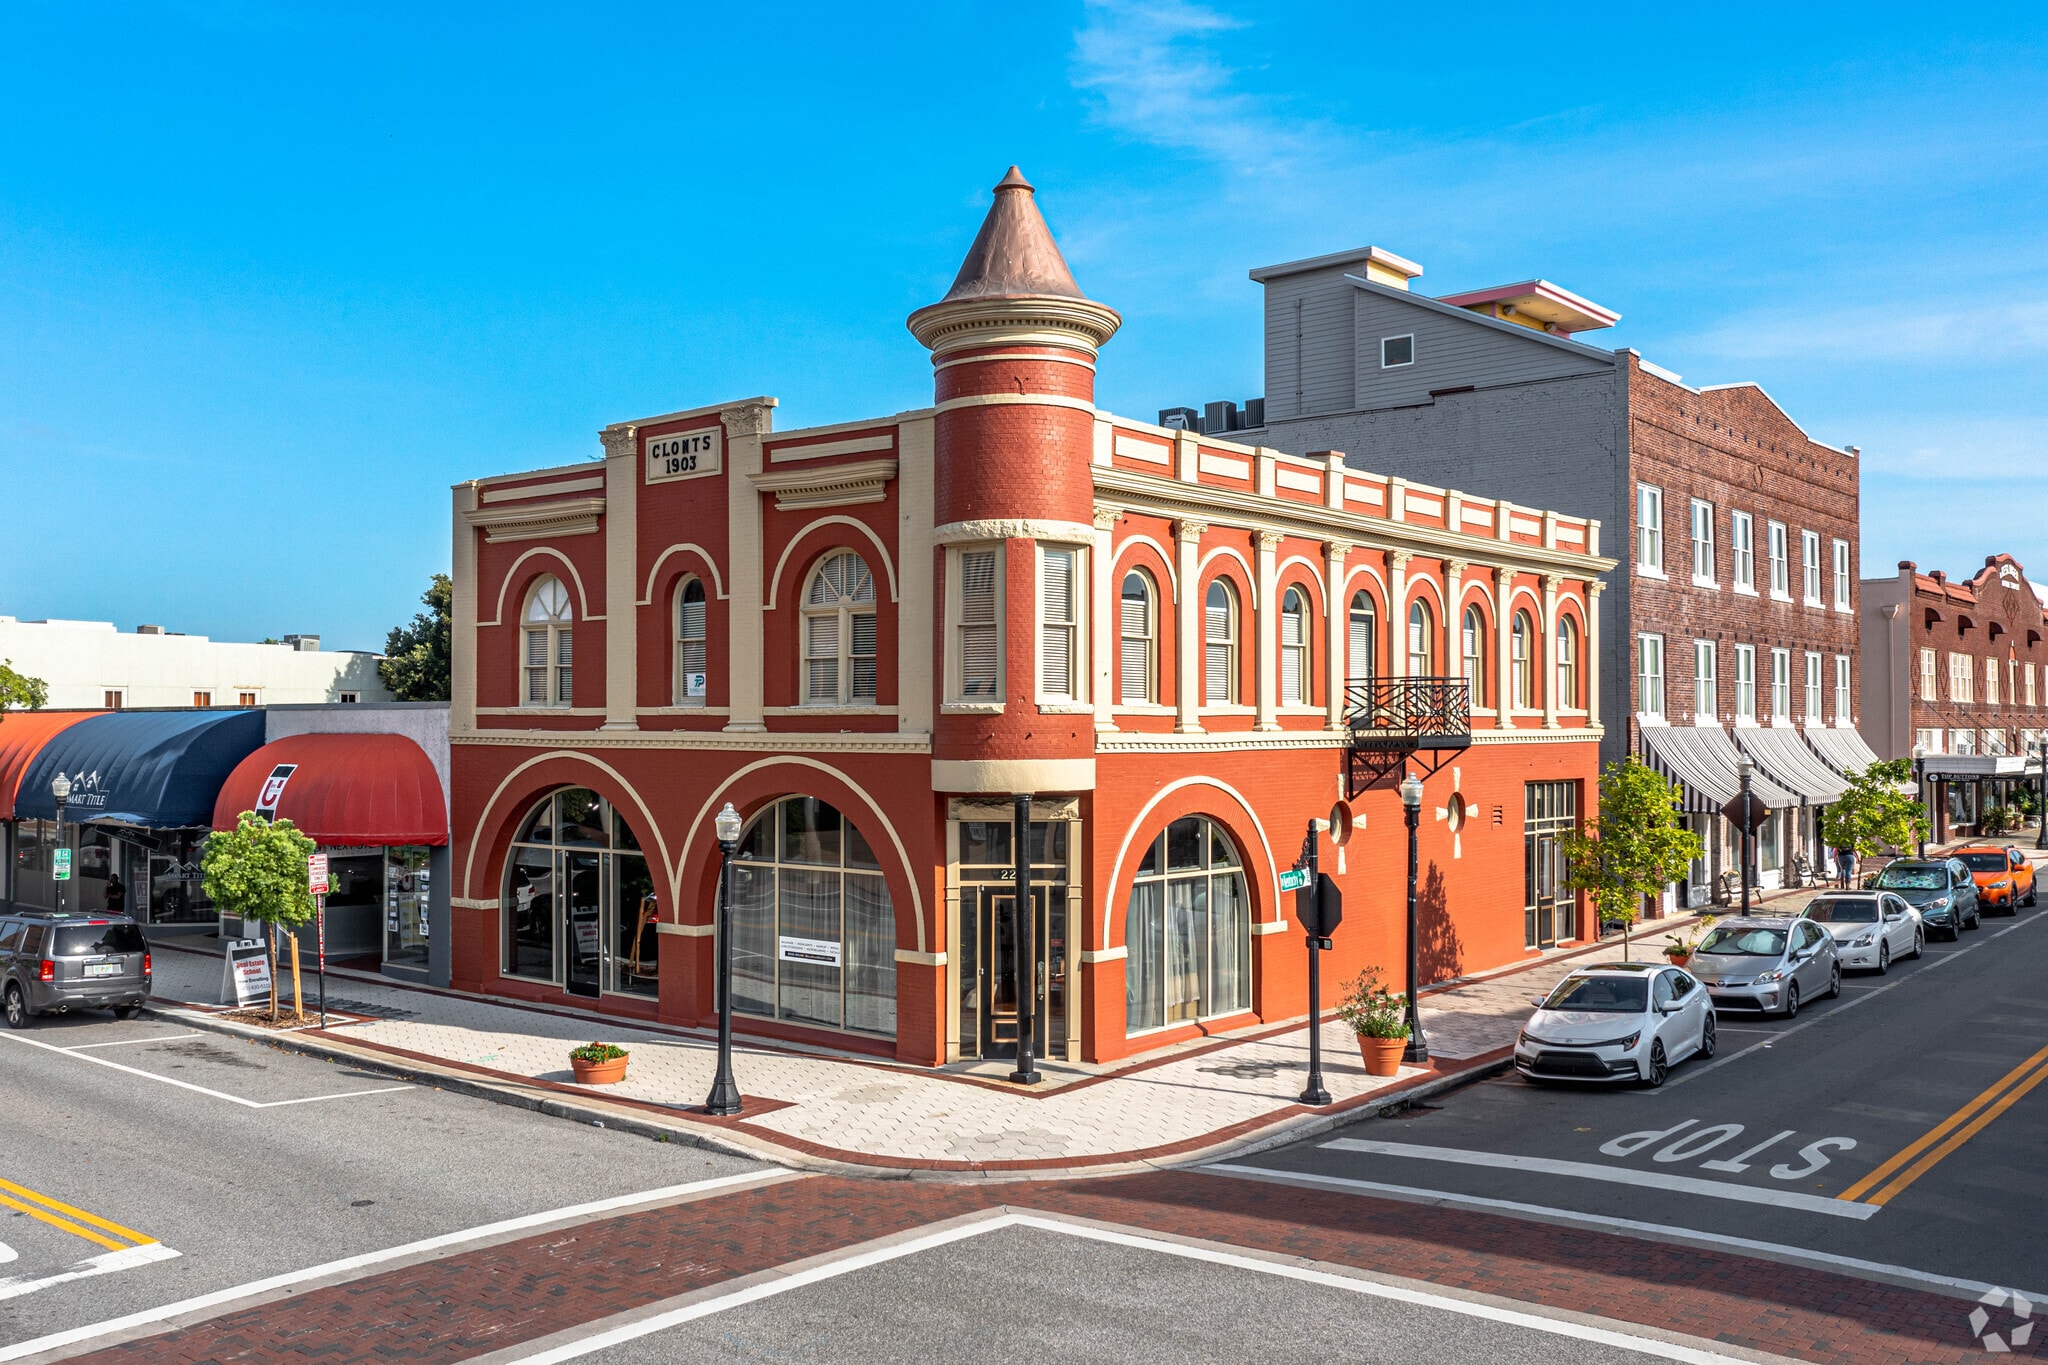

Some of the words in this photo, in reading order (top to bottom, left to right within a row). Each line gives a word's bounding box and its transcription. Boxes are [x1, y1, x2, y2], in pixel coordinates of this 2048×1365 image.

[652, 435, 711, 459] CLONTS
[666, 455, 697, 474] 1903
[86, 793, 106, 806] TITLE
[243, 967, 262, 976] School
[1599, 1119, 1857, 1180] STOP
